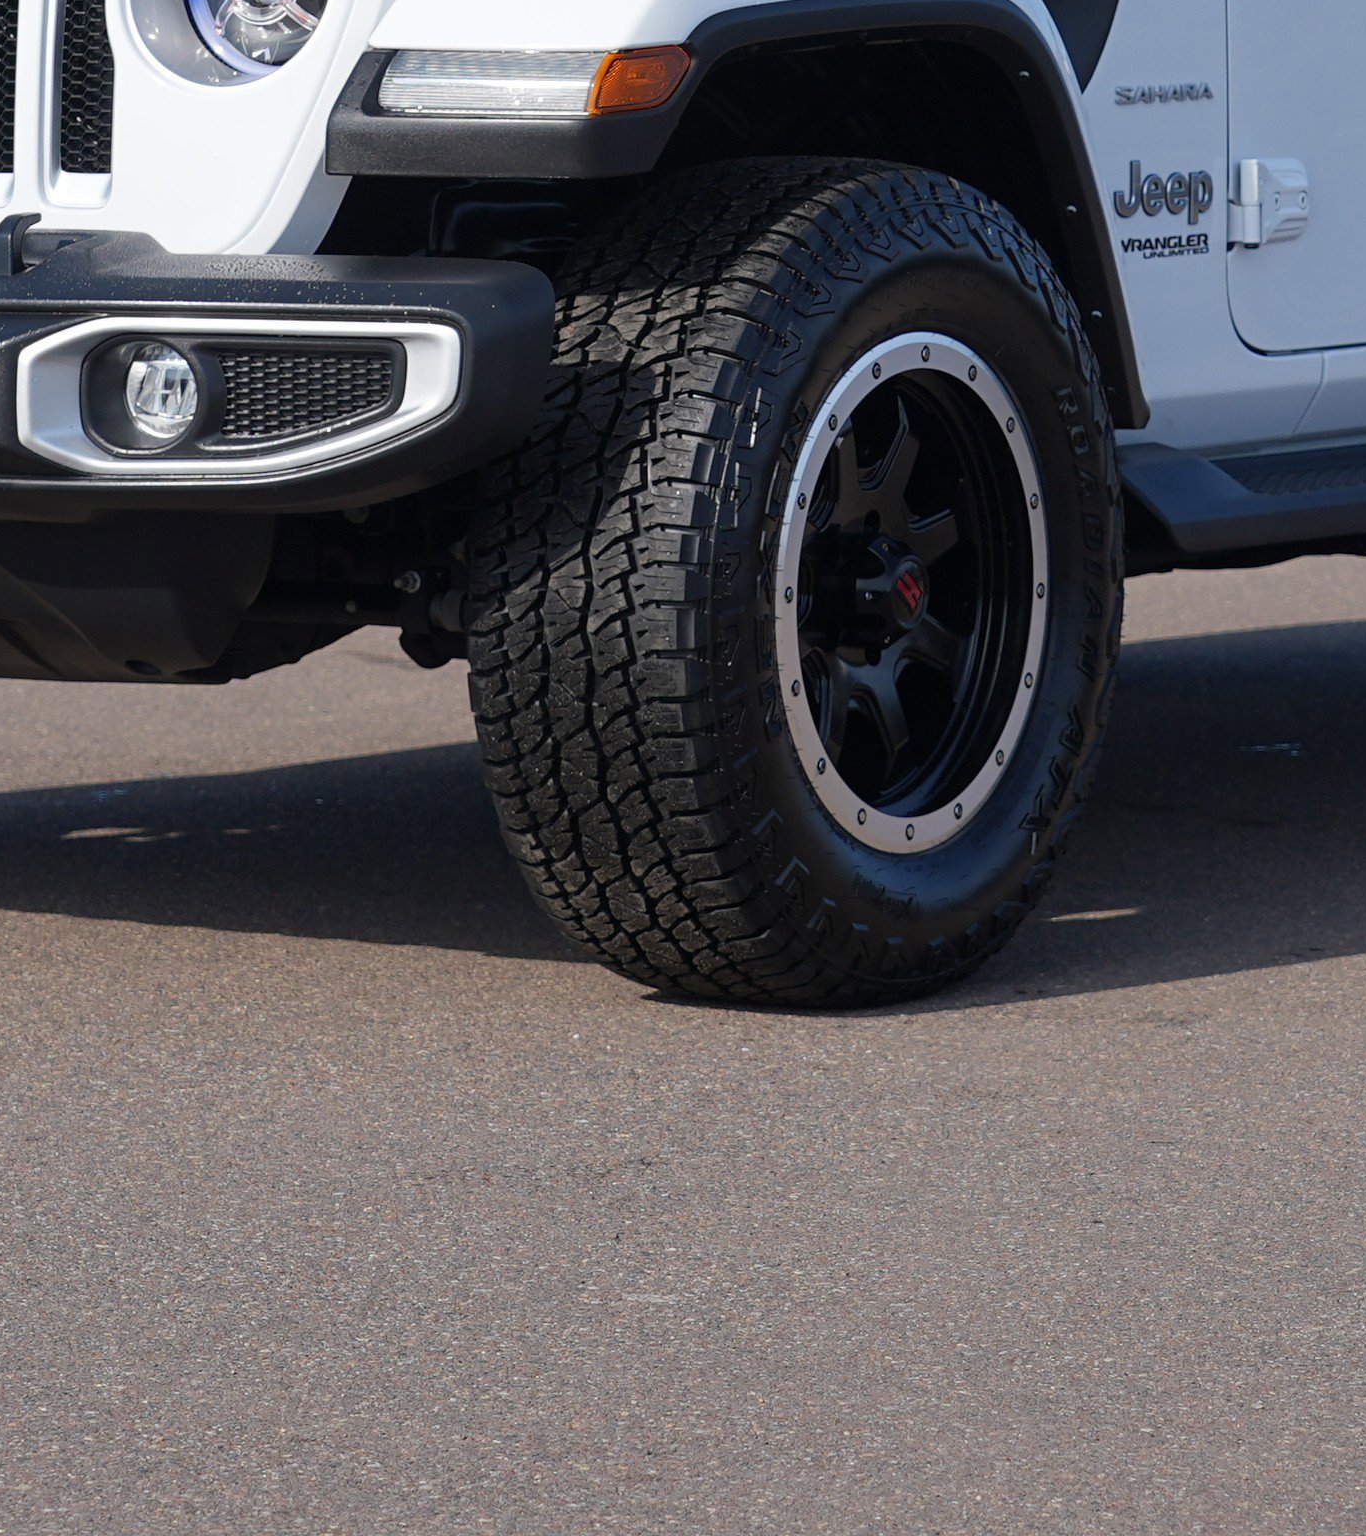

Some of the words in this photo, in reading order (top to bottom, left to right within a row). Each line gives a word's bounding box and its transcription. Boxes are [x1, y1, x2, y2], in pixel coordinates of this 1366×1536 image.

[1114, 82, 1214, 106] SAHARA
[1113, 160, 1214, 226] Jeep
[1143, 246, 1210, 260] UNLIMITED
[1052, 385, 1106, 682] ROADIAN
